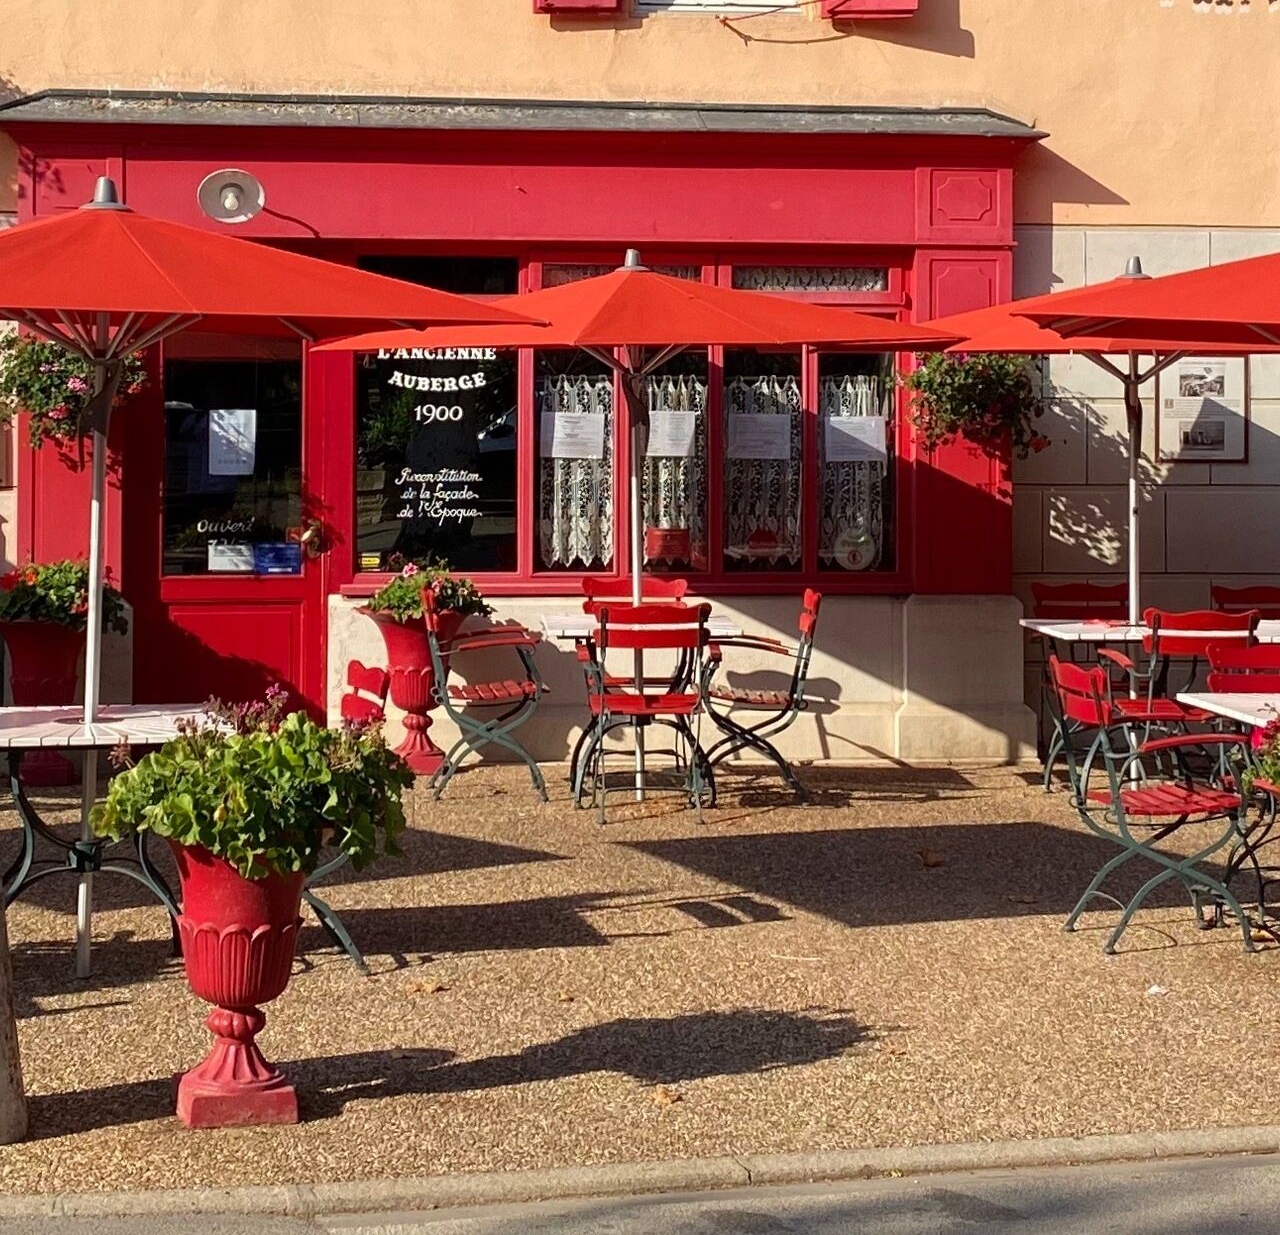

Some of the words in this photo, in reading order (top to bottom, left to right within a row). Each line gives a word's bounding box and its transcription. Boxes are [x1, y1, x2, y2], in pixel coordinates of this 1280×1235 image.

[377, 347, 497, 361] L'ANCIENNE
[387, 370, 487, 393] AUBERGE
[413, 403, 464, 426] 1900
[419, 483, 432, 499] la
[396, 503, 414, 518] de
